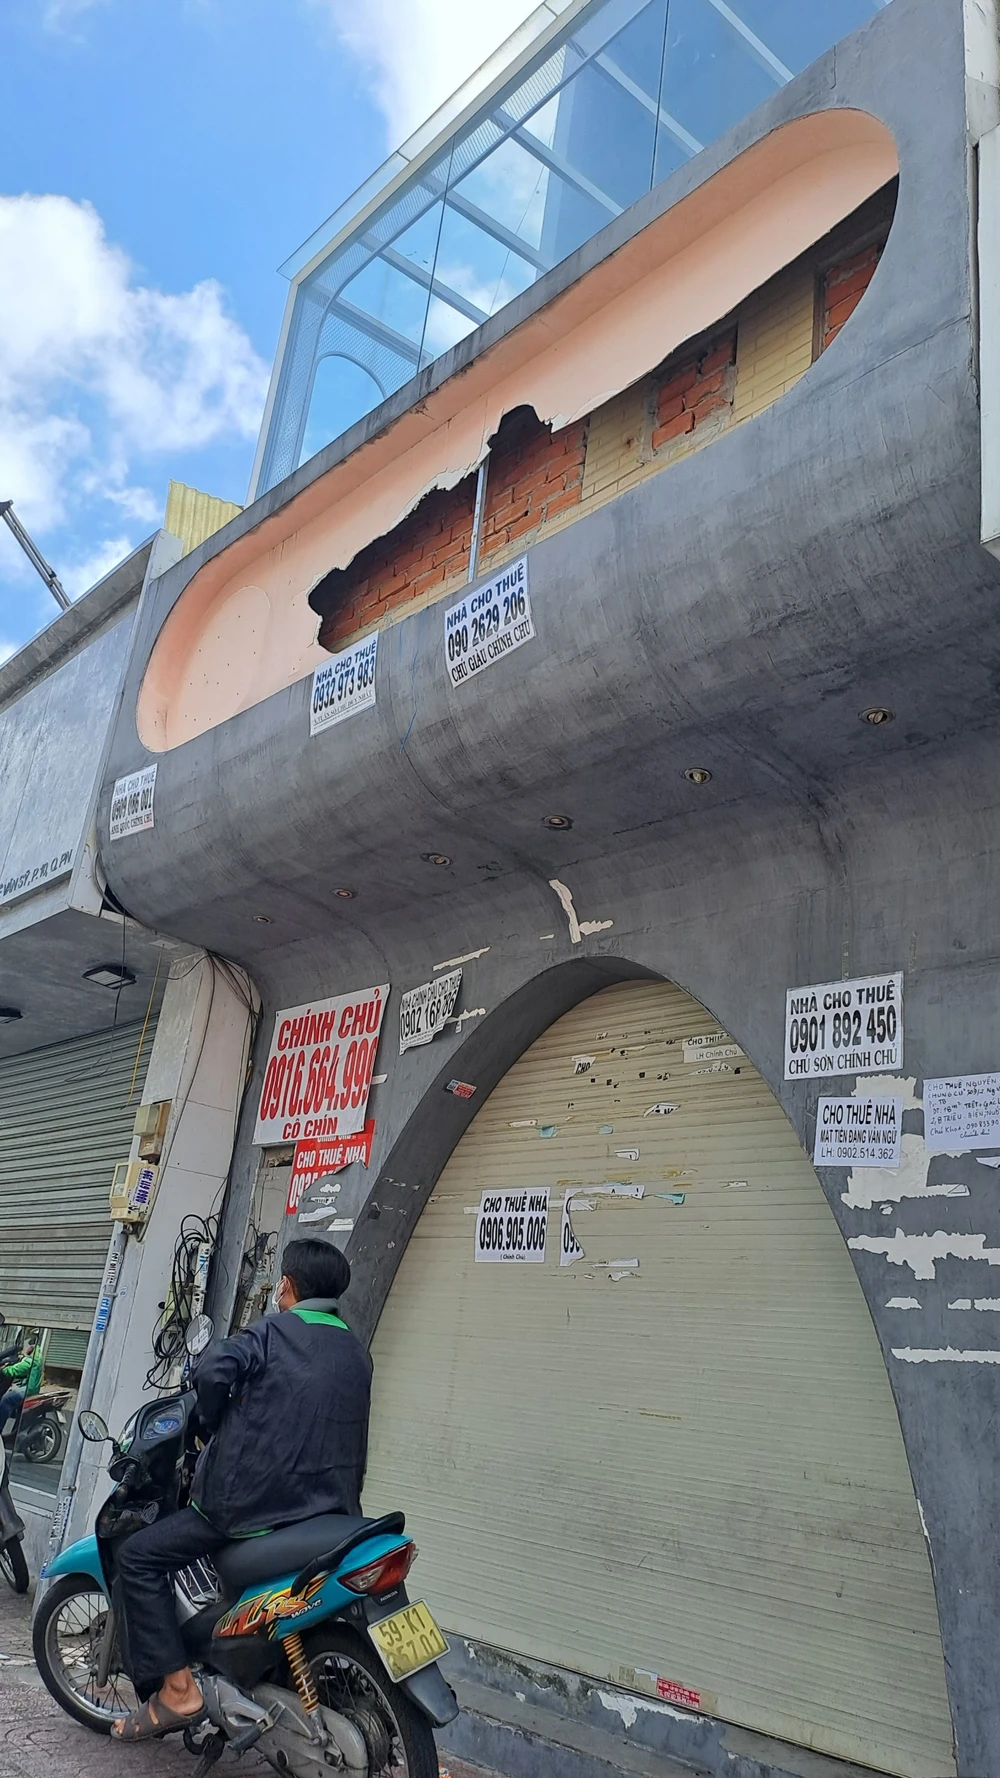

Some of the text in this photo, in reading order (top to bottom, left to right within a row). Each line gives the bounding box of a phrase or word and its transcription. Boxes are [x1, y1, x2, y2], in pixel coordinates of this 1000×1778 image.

[446, 562, 524, 630] NHÀ CHO THUÊ
[447, 586, 526, 662] 090 2629 206
[316, 640, 376, 685] NHÀ CHO THUÊ
[488, 634, 514, 659] CHÍNH
[313, 655, 374, 714] 0932 973 983
[790, 980, 895, 1015] NHÀ CHO THUÊ
[277, 988, 382, 1051] CHÍNH CHỦ
[400, 1006, 422, 1040] 0902
[790, 1004, 897, 1054] 0901 892 450
[838, 1049, 871, 1069] CHÍNH
[874, 1042, 898, 1066] CHỦ
[283, 1115, 338, 1140] CÔ CHÍN
[823, 1098, 896, 1124] CHO THUÊ NHÀ
[296, 1142, 366, 1168] CHO THUÊ NHÀ
[822, 1147, 894, 1160] LH: 0902.514.362
[484, 1196, 501, 1214] CHO
[504, 1192, 526, 1212] THUÊ
[529, 1190, 547, 1212] NHÀ
[480, 1216, 546, 1250] 0906.905.006
